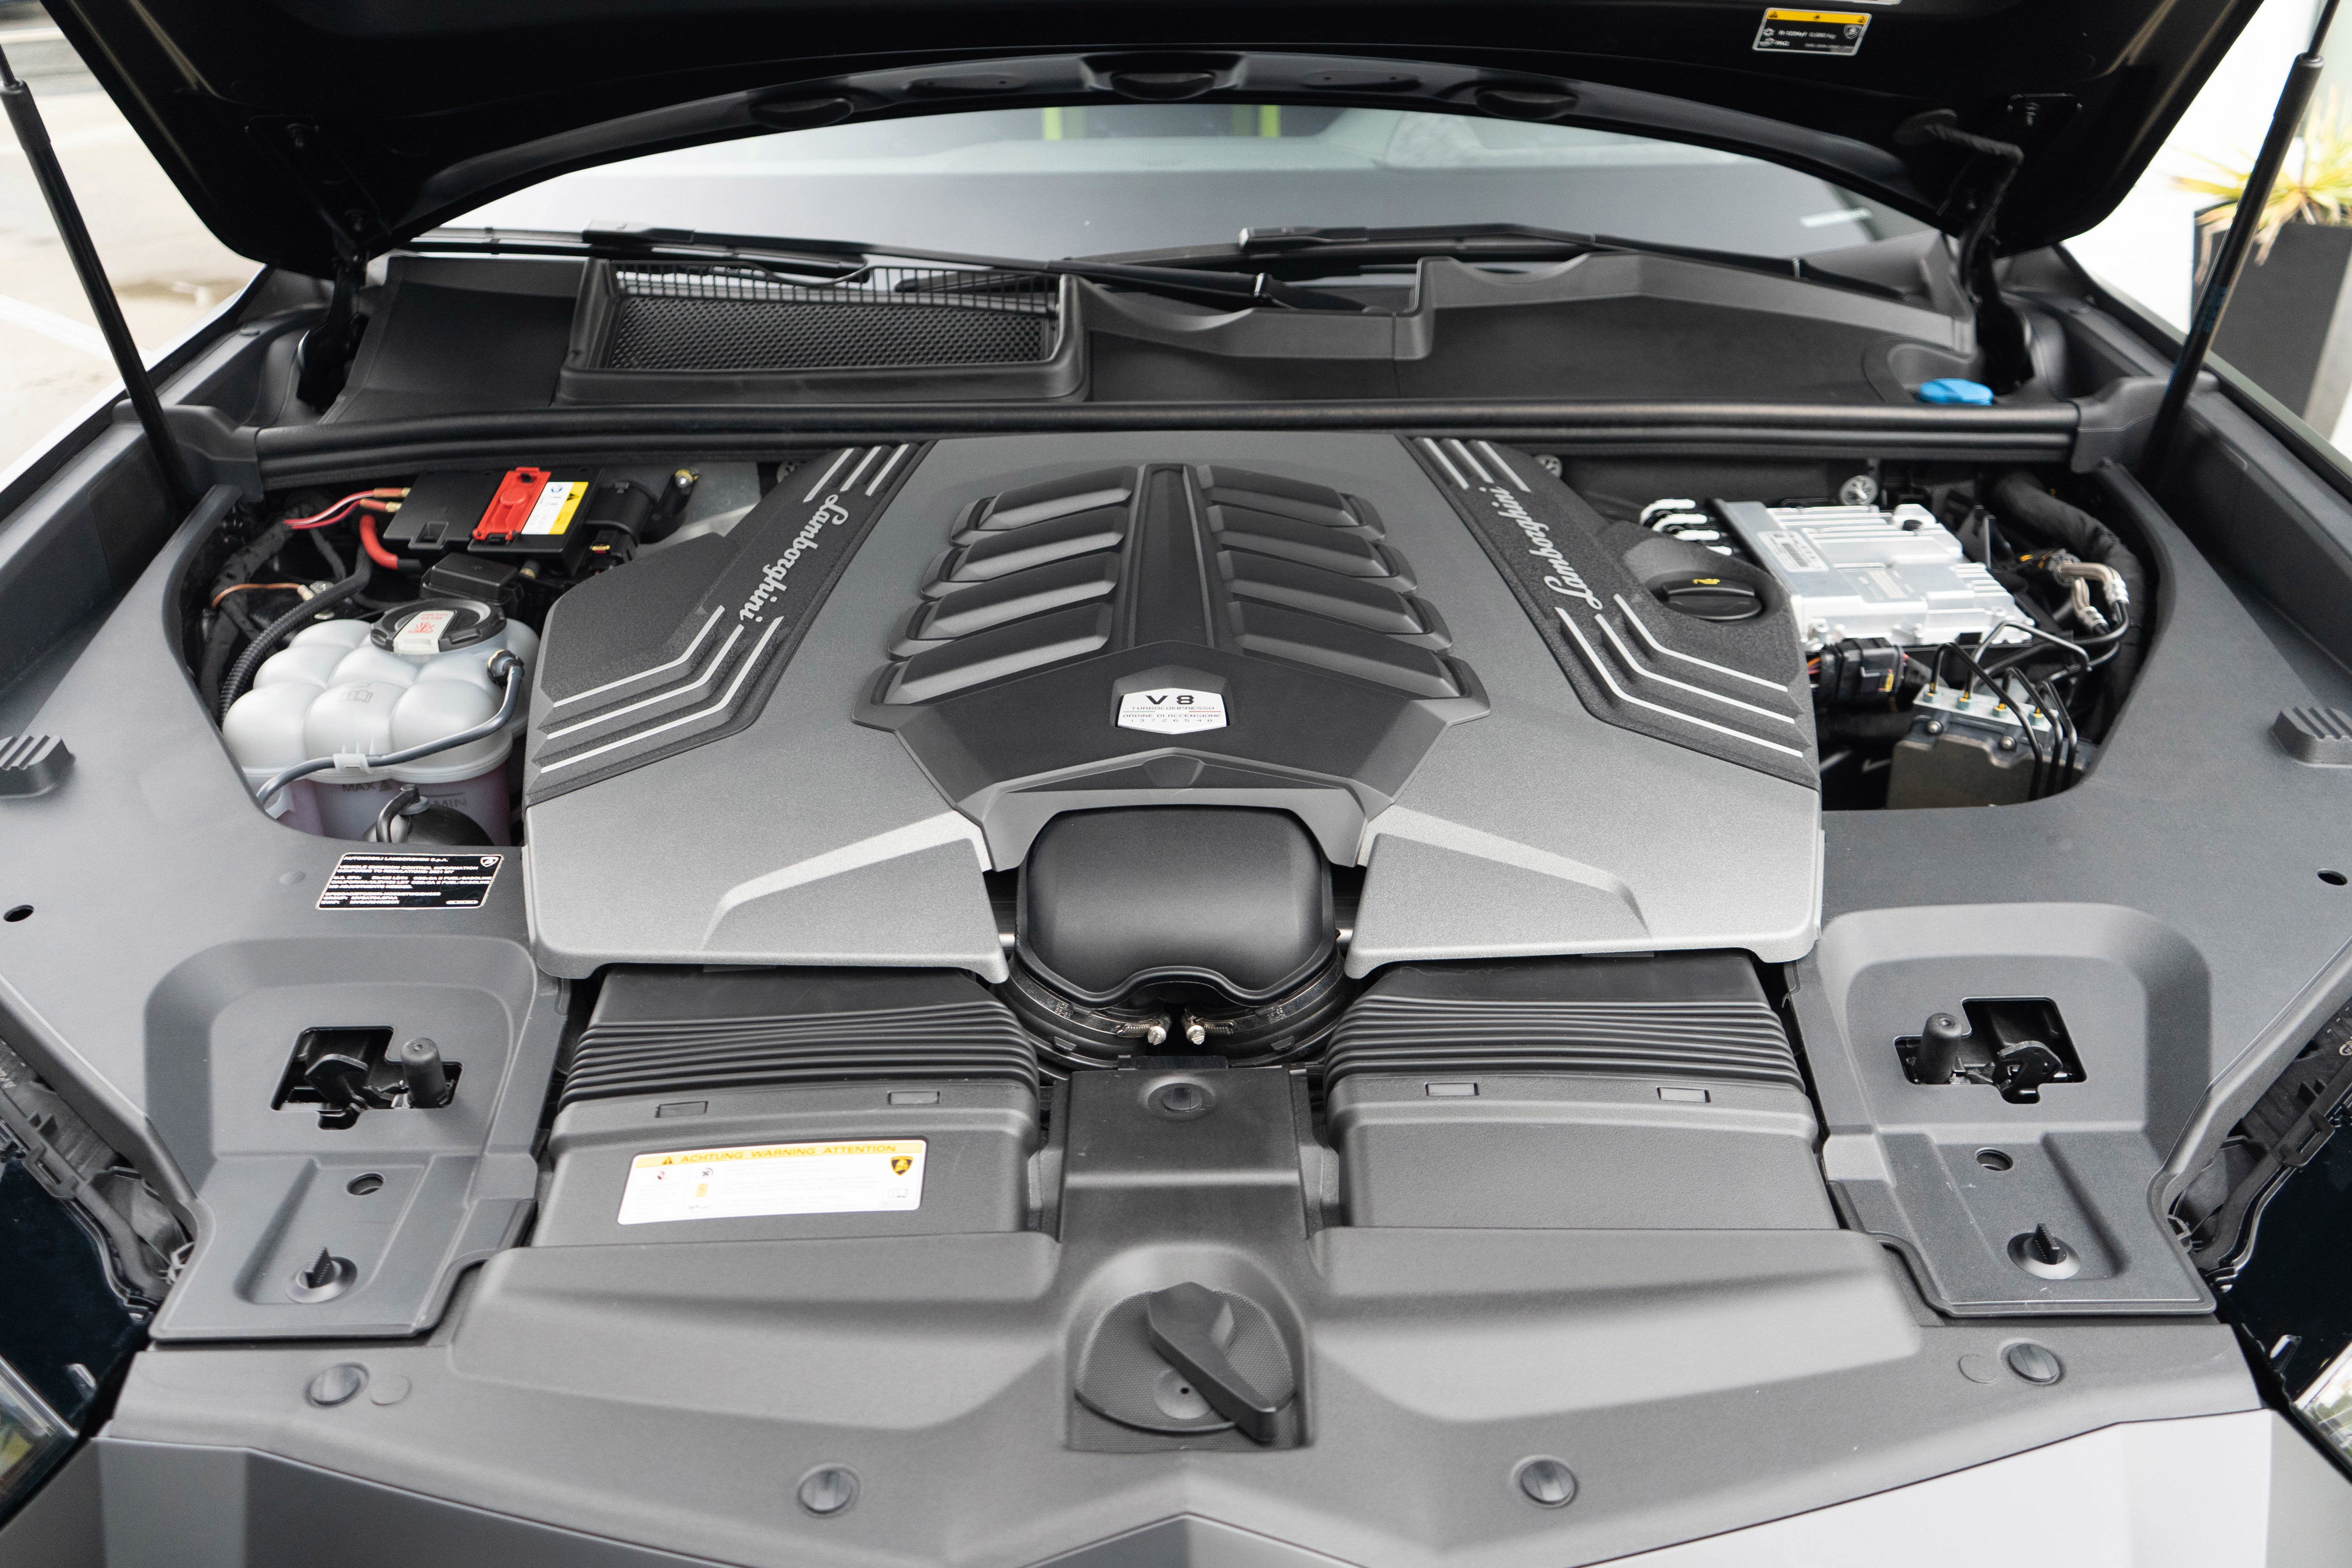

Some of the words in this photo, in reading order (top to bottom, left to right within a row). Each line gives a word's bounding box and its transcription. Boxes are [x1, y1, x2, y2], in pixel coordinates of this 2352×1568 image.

[739, 494, 849, 623] Lamborghini
[1478, 486, 1603, 610] Lamborghini
[342, 783, 376, 792] MAX
[680, 1152, 743, 1163] ACHTUNG
[751, 1148, 815, 1158] WARNING
[823, 1145, 896, 1154] ATTENTION
